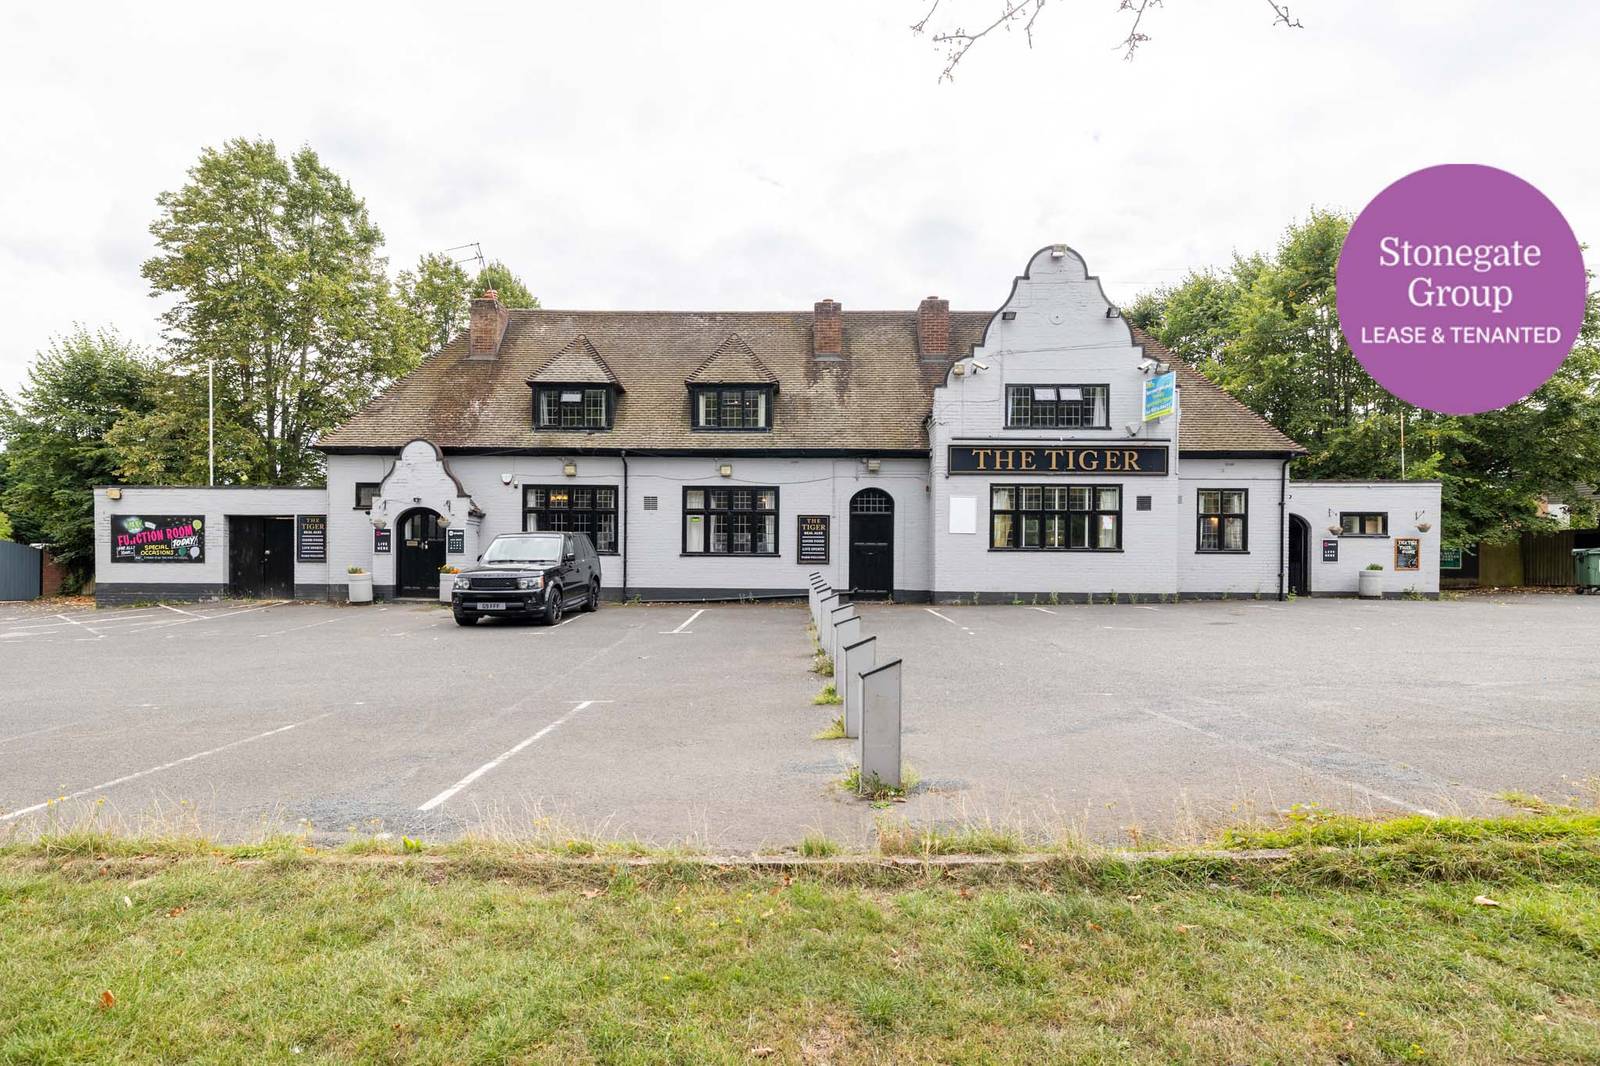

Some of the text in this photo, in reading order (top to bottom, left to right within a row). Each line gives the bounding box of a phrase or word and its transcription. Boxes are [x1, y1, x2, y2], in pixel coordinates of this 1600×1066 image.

[971, 449, 1142, 471] THE TIGER
[166, 524, 193, 539] ROOM
